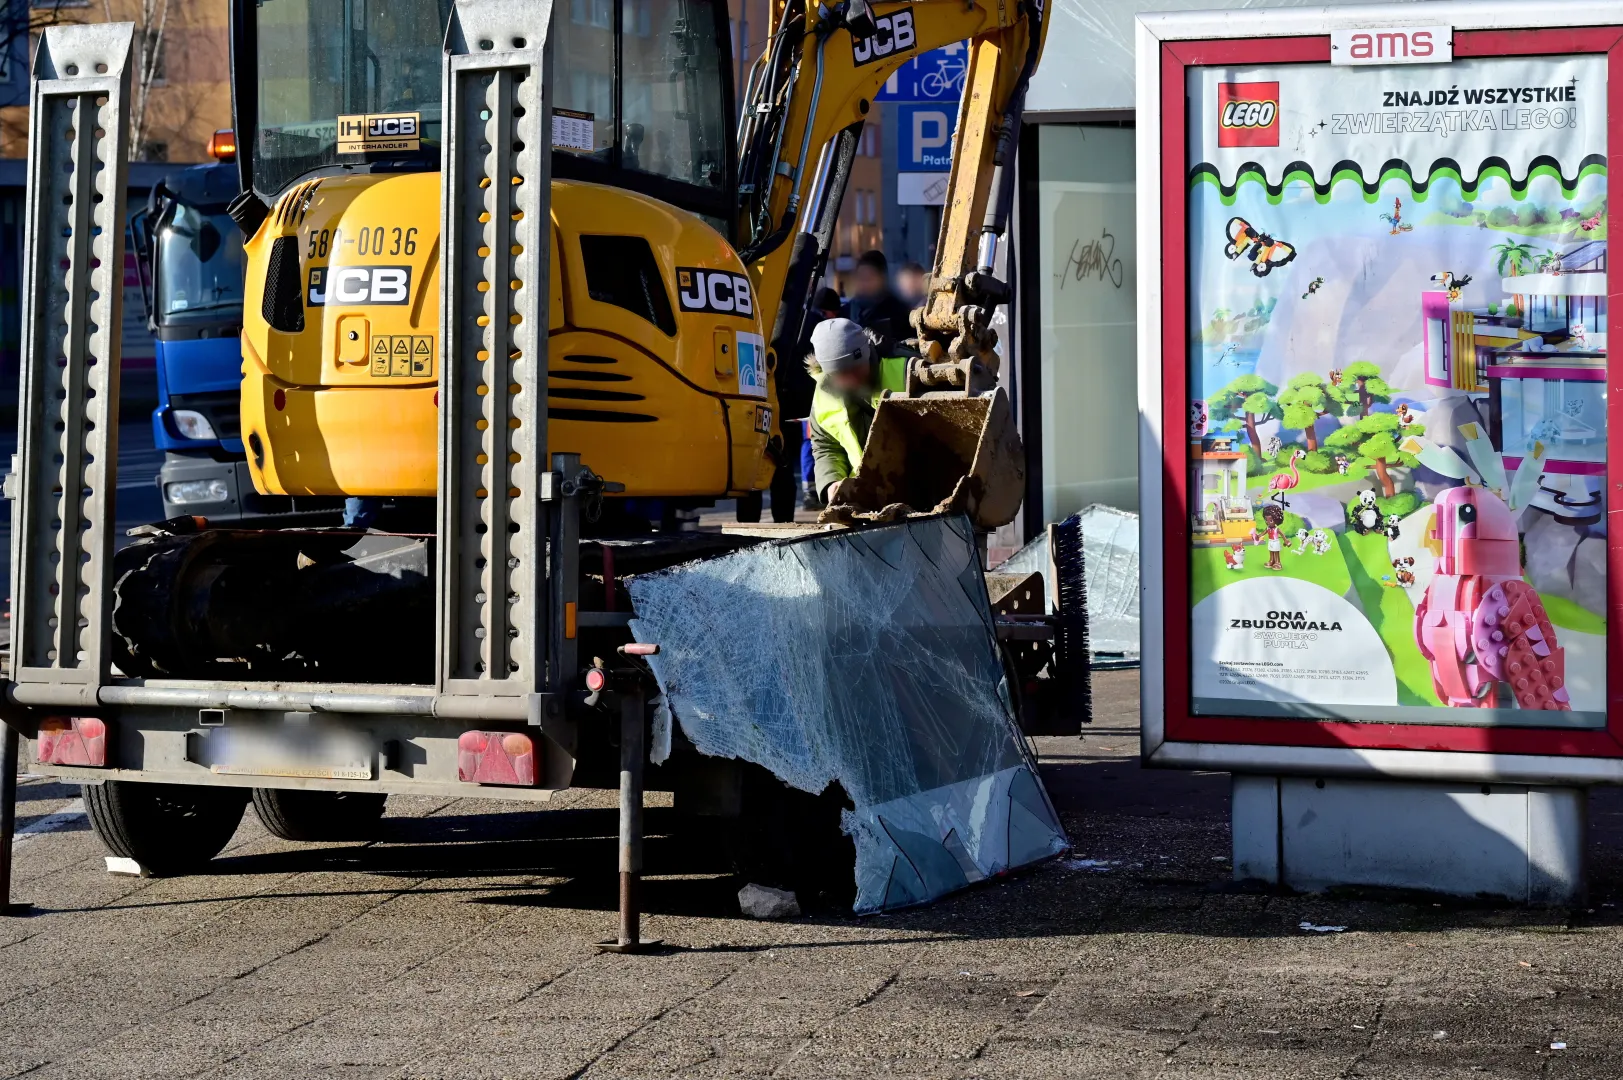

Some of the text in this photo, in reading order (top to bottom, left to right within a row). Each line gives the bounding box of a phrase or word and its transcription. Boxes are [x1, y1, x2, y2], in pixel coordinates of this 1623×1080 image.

[854, 11, 915, 62] JCB
[1350, 31, 1434, 59] ams
[1383, 85, 1576, 107] ZNAJDŹ WSZYSTKIE
[1221, 101, 1278, 128] LEGO
[1331, 107, 1577, 138] ZWIERZĄTKA LEGO!
[340, 118, 416, 136] IH JCB
[912, 111, 948, 163] P
[348, 142, 408, 150] INTERHANDLER
[309, 268, 408, 303] JCB
[681, 272, 753, 315] JCB
[1230, 619, 1343, 631] ZBUDOWAŁA
[1266, 611, 1306, 620] ONA
[1254, 631, 1318, 642] SWOJEGO
[1263, 640, 1309, 649] PUPILA
